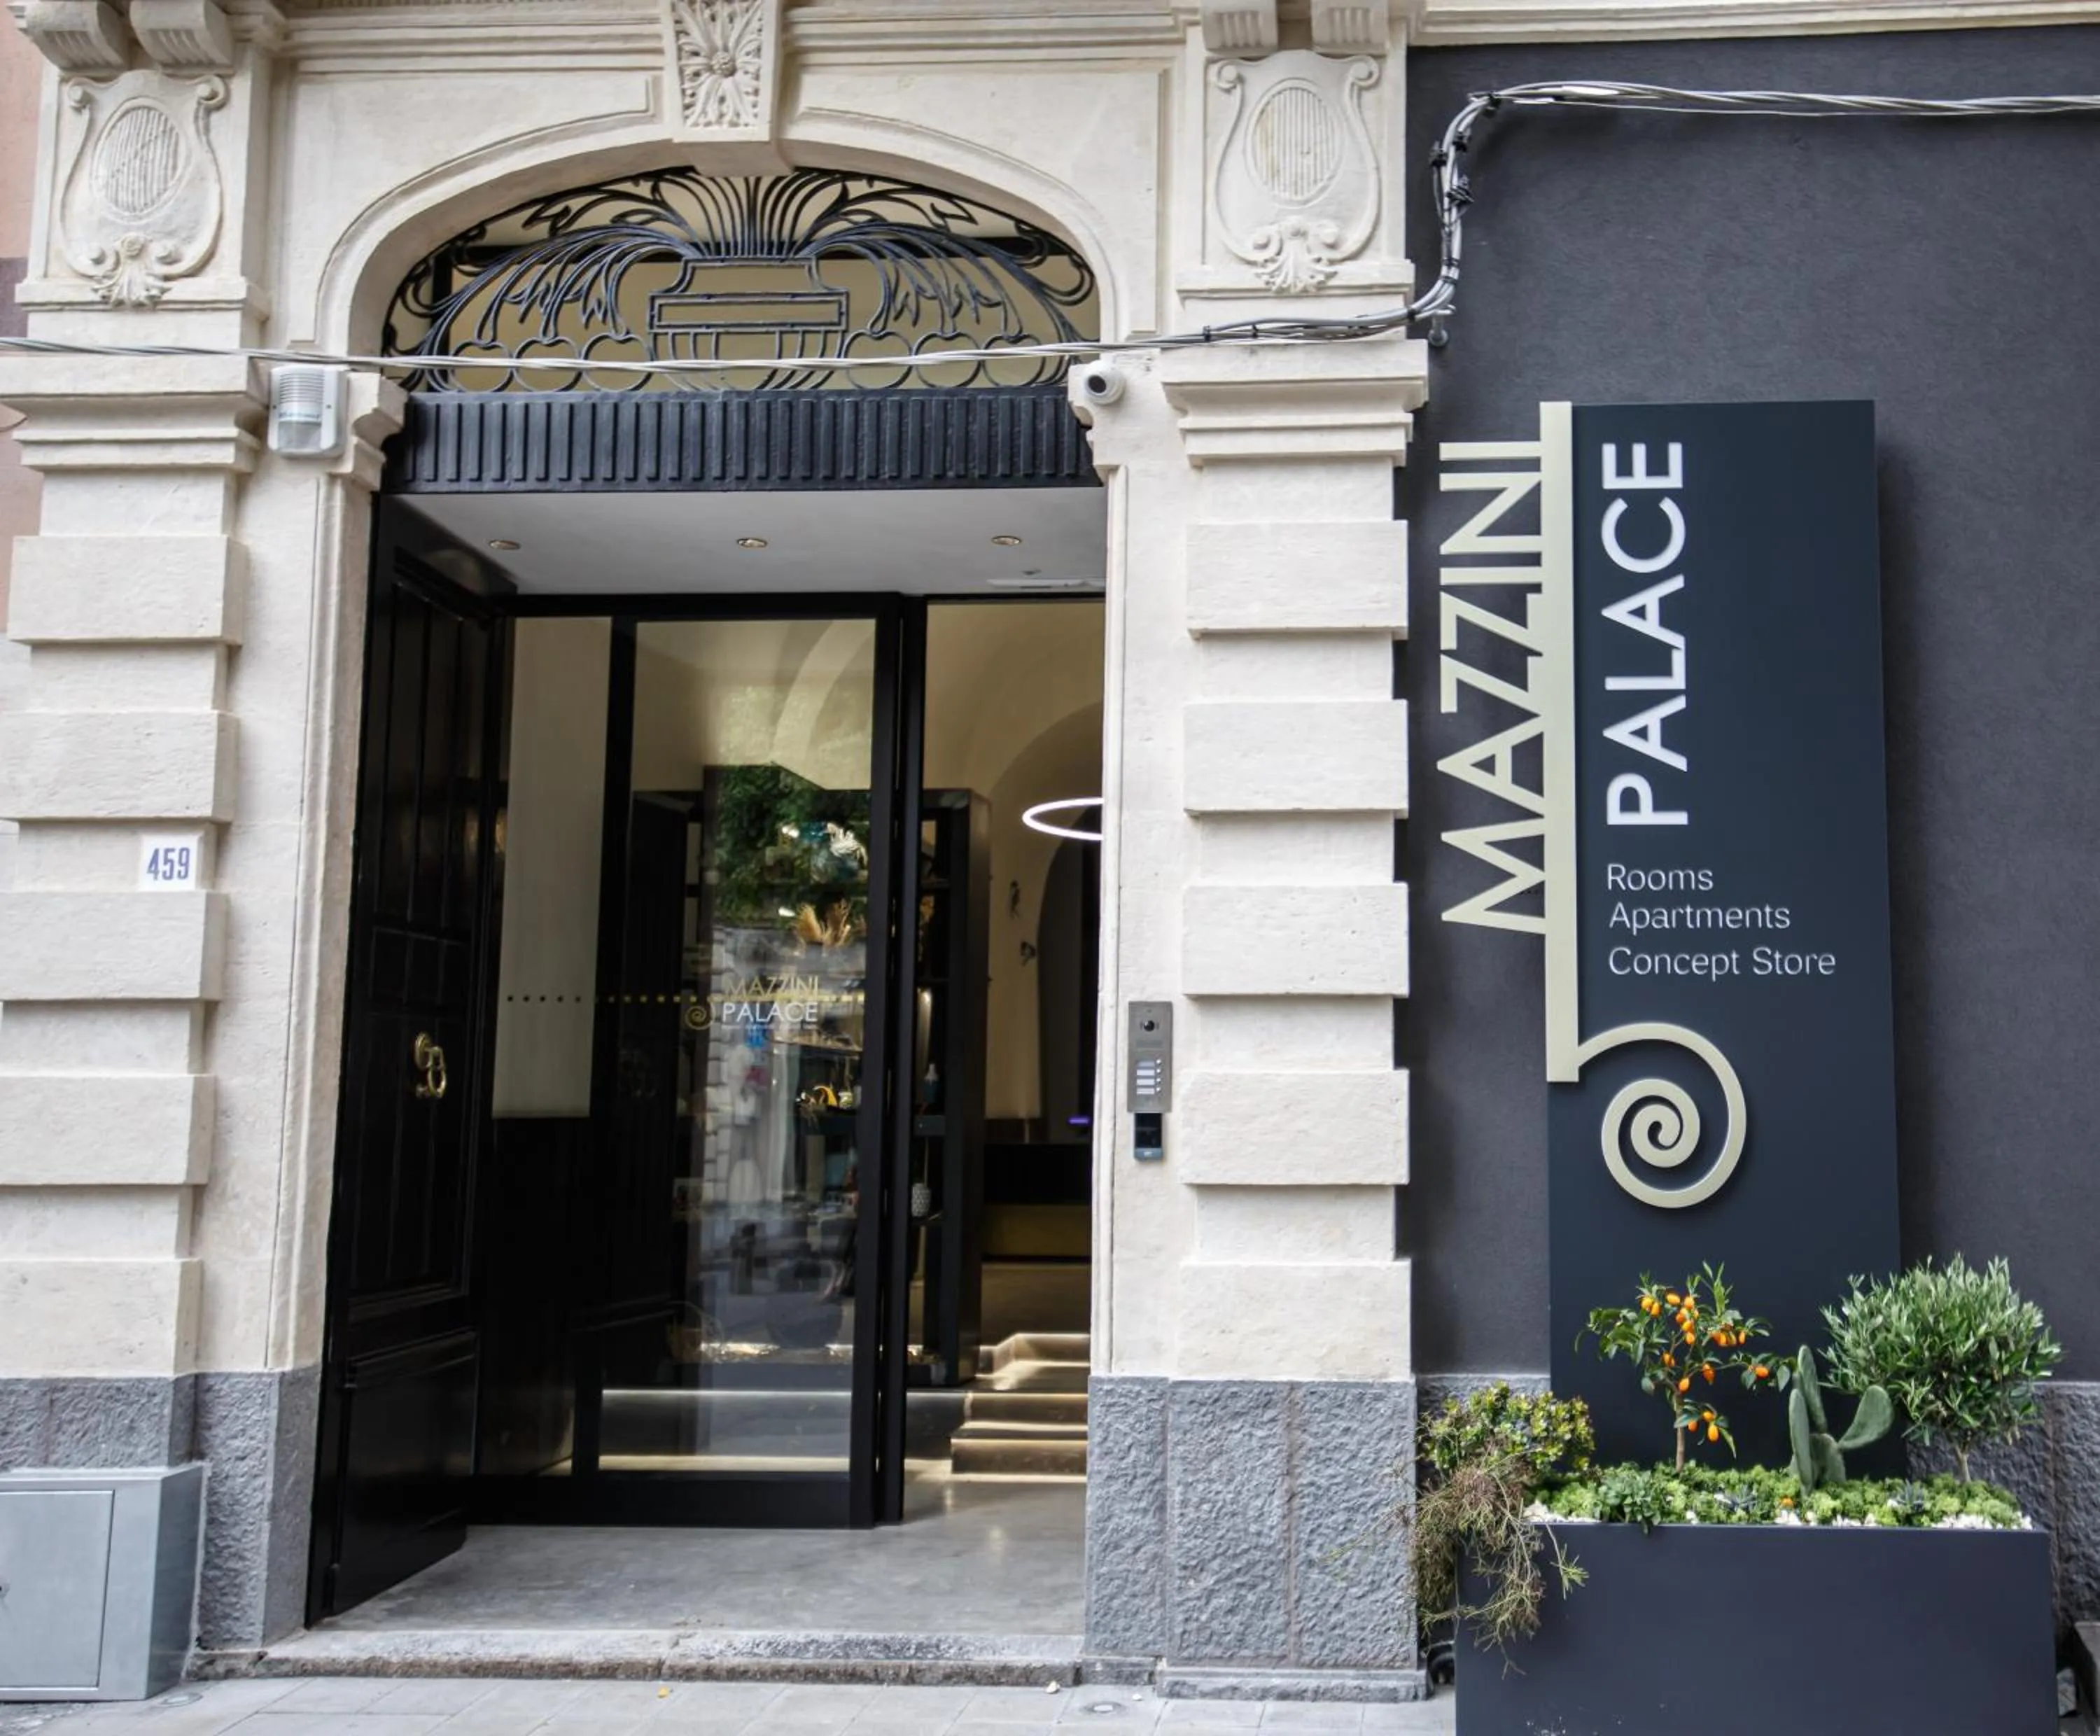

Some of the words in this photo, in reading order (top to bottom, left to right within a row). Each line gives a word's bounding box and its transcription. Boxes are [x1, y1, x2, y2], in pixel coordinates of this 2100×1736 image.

[1602, 442, 1688, 825] PALACE
[1437, 441, 1545, 934] MAZZINI
[146, 847, 190, 881] 459
[1607, 863, 1714, 890] Rooms
[1609, 902, 1791, 936] Apartments
[1609, 947, 1740, 981] Concept
[1752, 947, 1836, 975] Store
[722, 976, 818, 997] MAZZINI
[722, 1002, 818, 1022] PALACE
